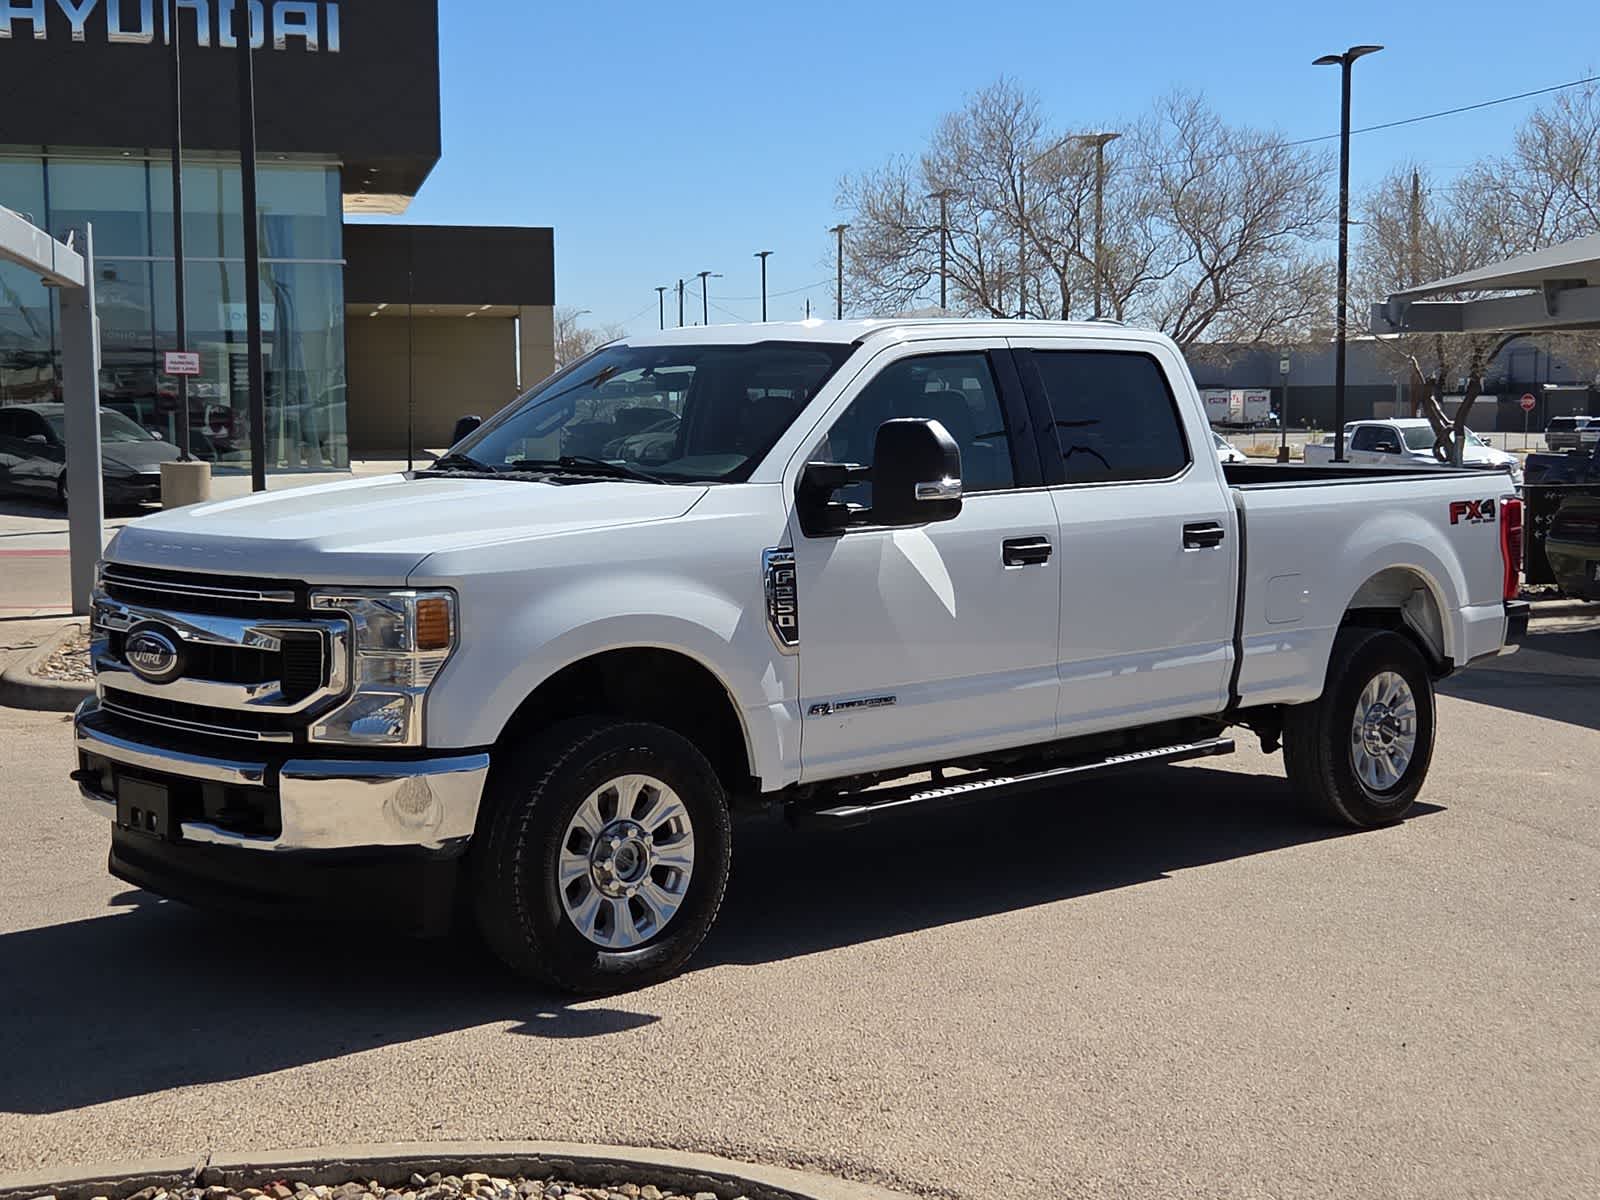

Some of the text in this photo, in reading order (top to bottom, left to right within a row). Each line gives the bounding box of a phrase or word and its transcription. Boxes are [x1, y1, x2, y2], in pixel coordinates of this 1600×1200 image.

[0, 0, 340, 53] HYUNDAI
[1449, 499, 1496, 525] FX4
[132, 640, 166, 665] Ford
